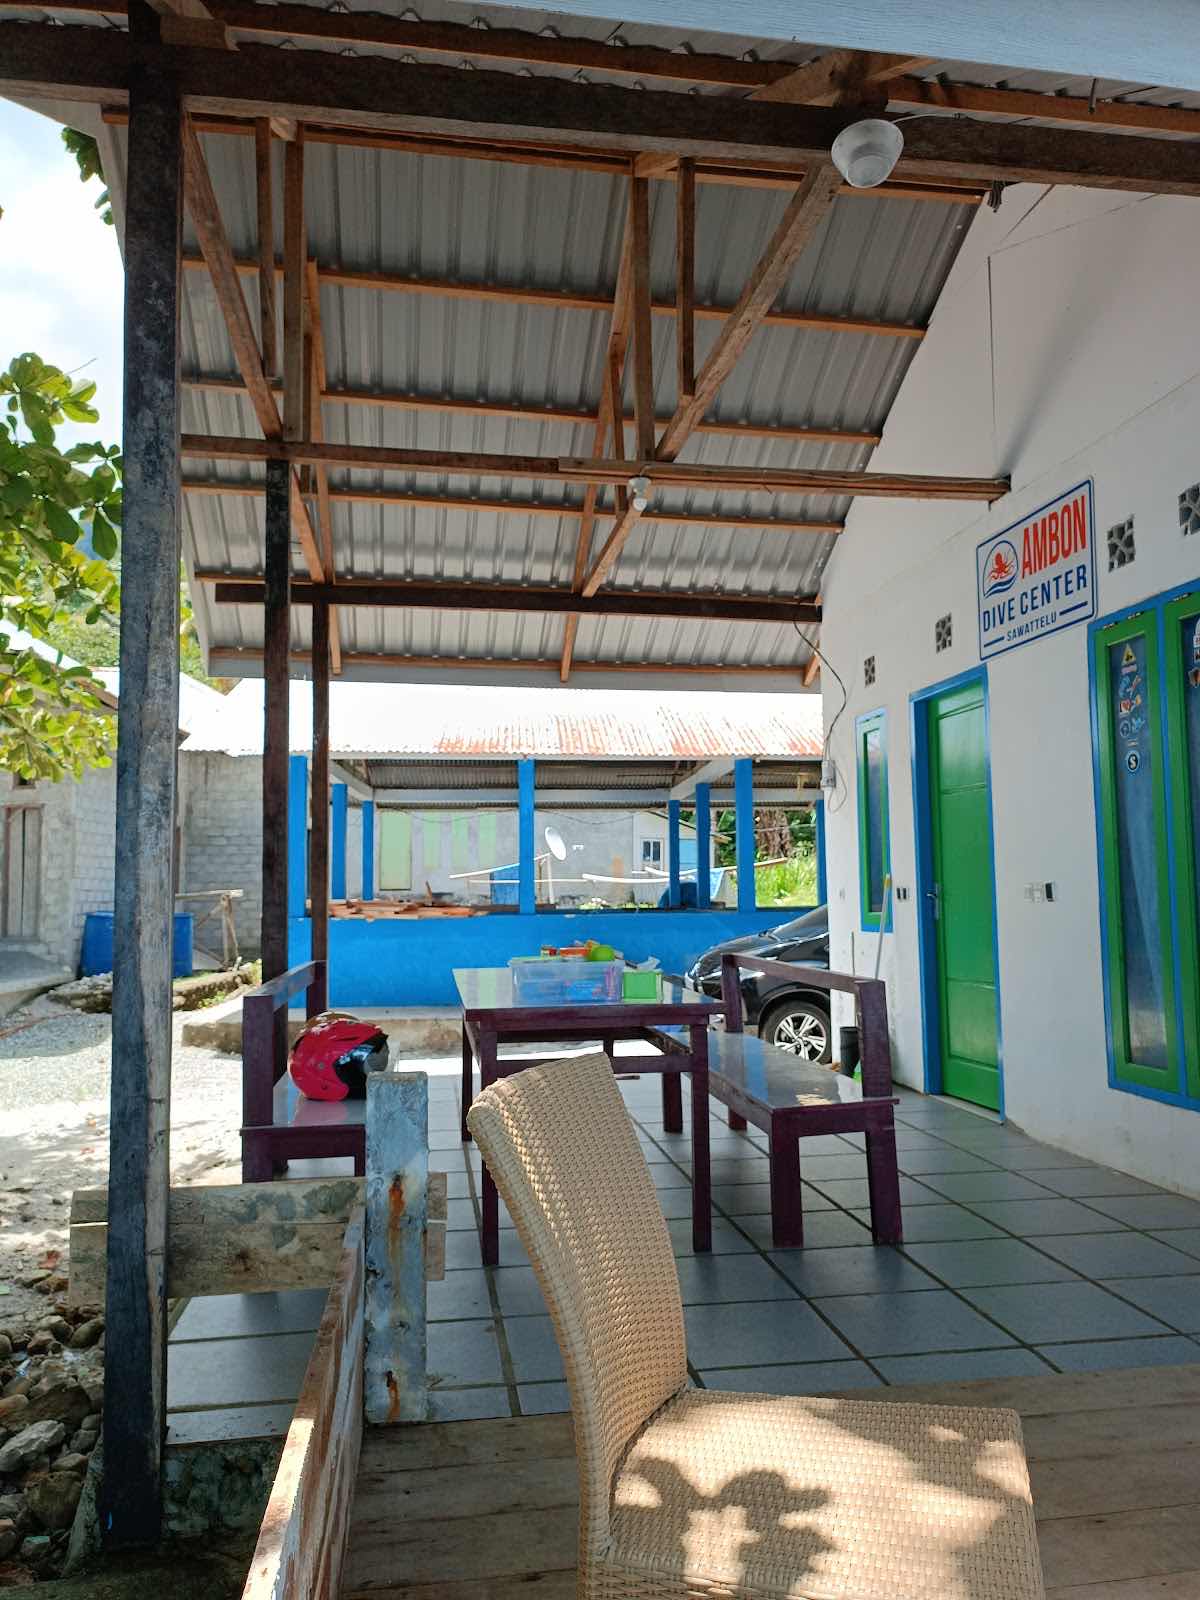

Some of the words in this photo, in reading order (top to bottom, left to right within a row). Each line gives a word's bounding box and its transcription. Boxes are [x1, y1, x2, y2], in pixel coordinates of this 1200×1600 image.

[1021, 495, 1086, 579] AMBON
[983, 598, 1015, 632] DIVE
[1020, 564, 1087, 615] CENTER
[1006, 611, 1057, 641] SAWATTELU
